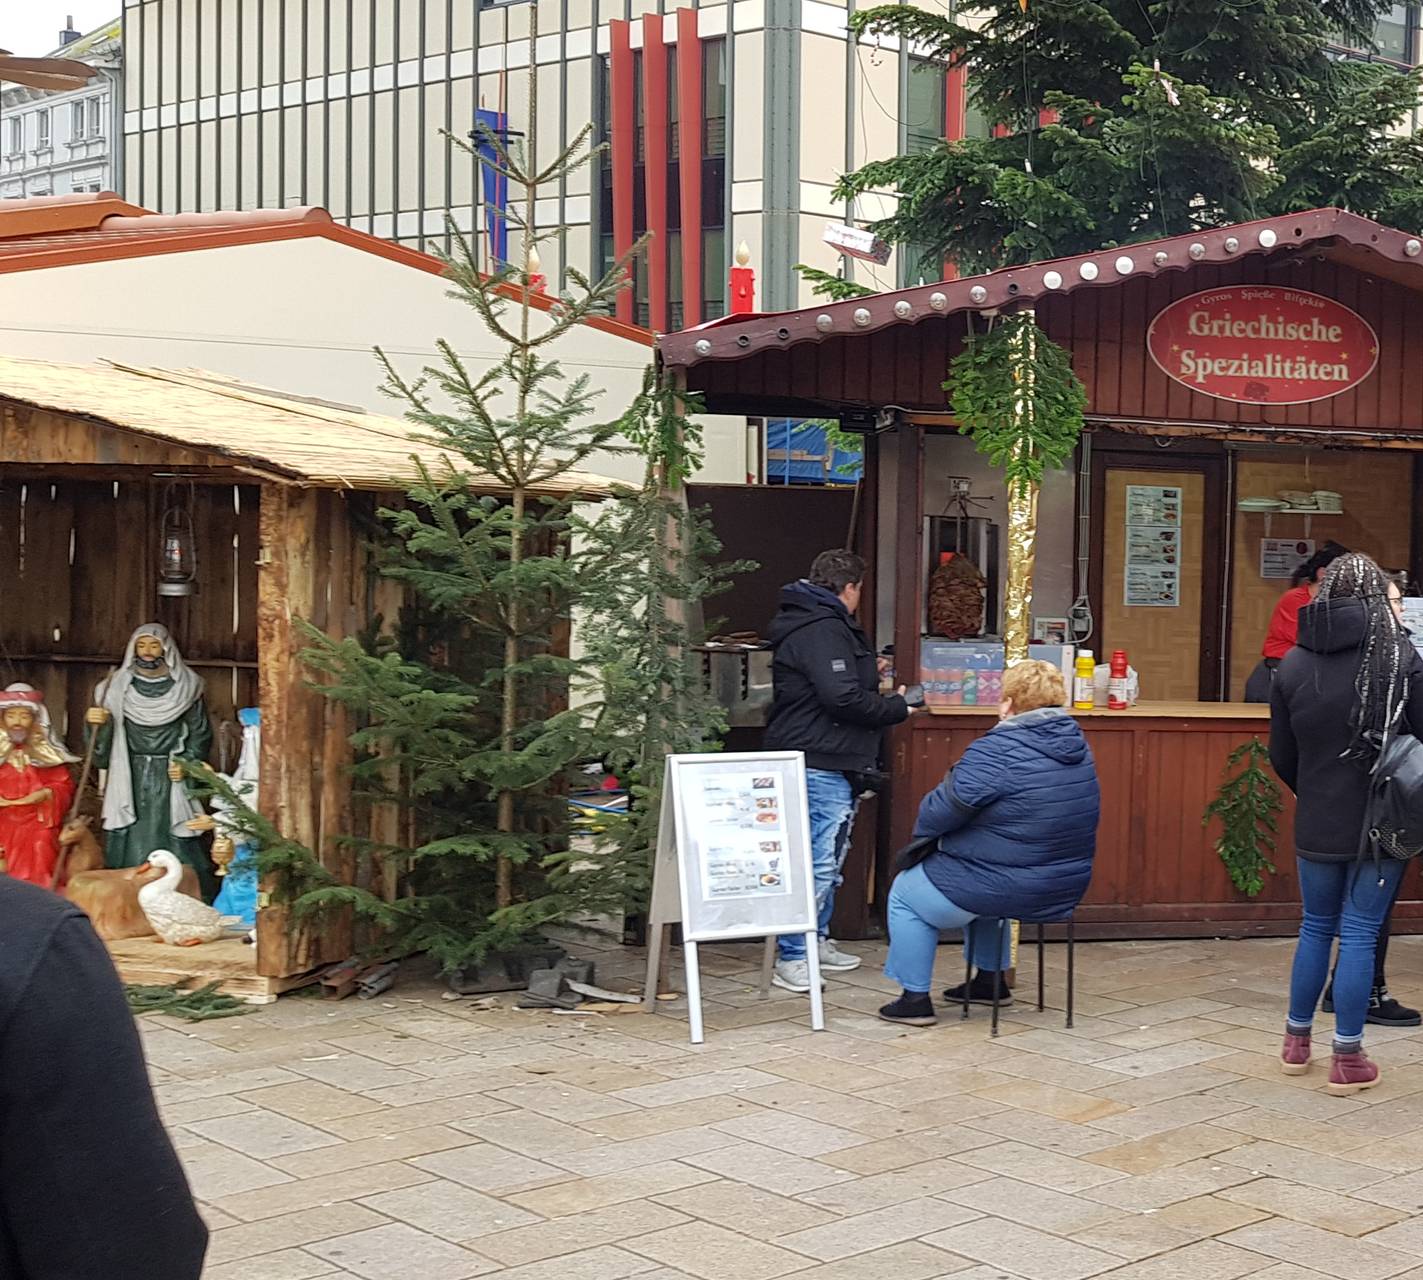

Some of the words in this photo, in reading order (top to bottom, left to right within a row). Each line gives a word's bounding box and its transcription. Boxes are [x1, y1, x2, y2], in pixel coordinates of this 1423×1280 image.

[1201, 293, 1232, 304] Gyros
[1189, 311, 1342, 342] Griechische
[1180, 350, 1349, 383] Spezialitäten
